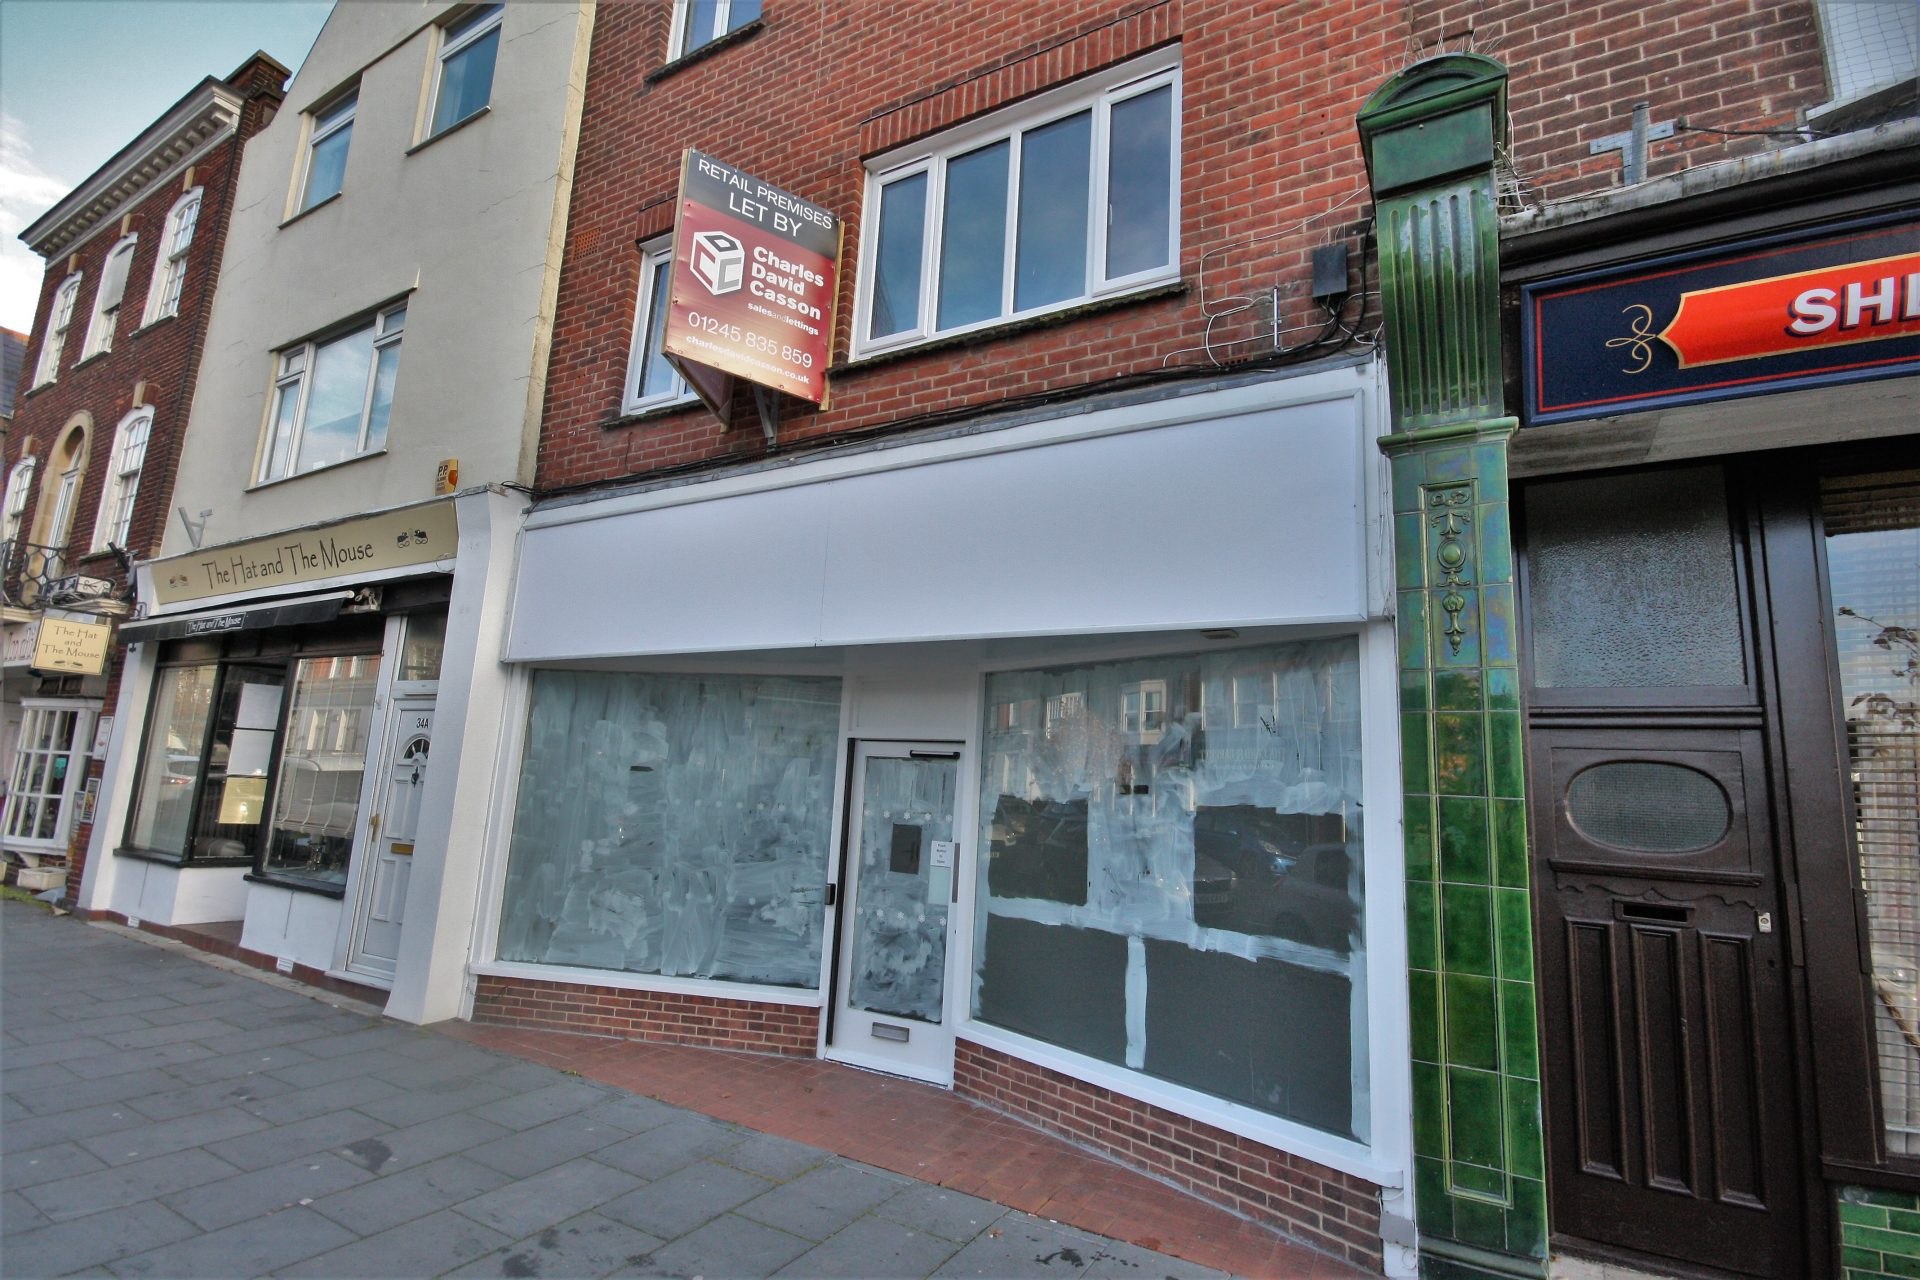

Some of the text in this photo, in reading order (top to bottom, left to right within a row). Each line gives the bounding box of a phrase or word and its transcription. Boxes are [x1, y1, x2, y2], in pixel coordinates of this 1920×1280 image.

[698, 159, 833, 230] RETAIL PREMISES
[729, 192, 803, 237] LET BY
[751, 262, 805, 297] David
[753, 246, 824, 287] Charles
[749, 280, 821, 321] Casson
[688, 312, 813, 368] 01245 835 859
[202, 537, 374, 590] The Hat and The Mouse
[54, 625, 97, 640] The Hat
[64, 639, 83, 647] and
[187, 621, 197, 633] The
[224, 616, 242, 629] Mouse
[42, 643, 100, 659] The Mouse
[416, 717, 429, 729] 34A
